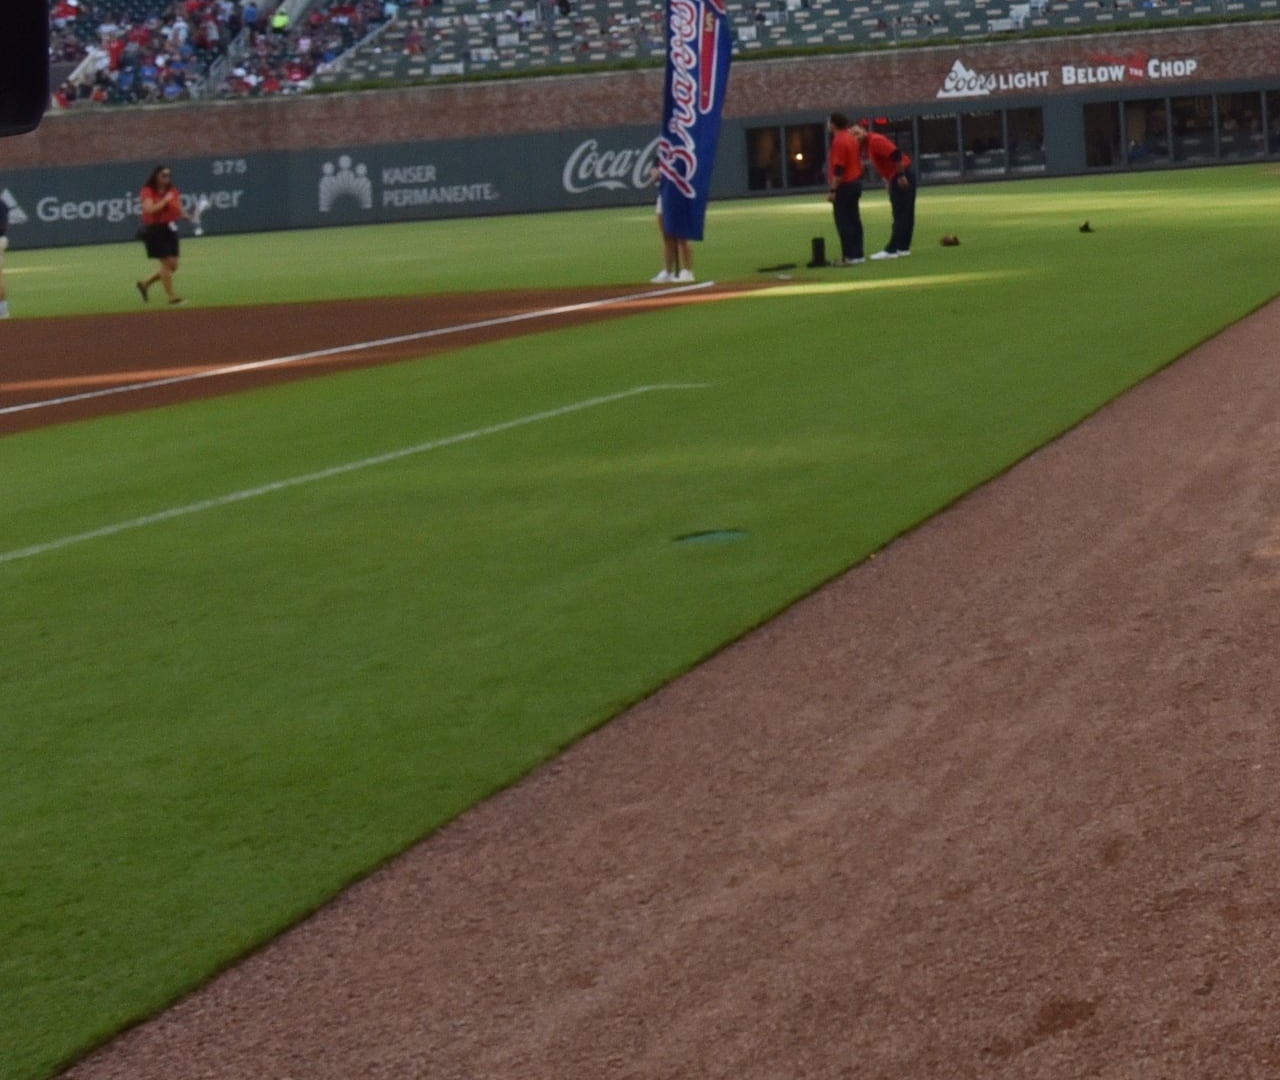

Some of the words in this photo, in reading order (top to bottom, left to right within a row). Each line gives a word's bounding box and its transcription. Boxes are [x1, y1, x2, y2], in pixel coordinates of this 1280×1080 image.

[943, 69, 998, 94] Coors
[999, 70, 1049, 91] LIGHT
[1062, 64, 1125, 85] BELOW
[1147, 59, 1197, 79] CHOP
[382, 165, 437, 185] KAISER
[36, 191, 144, 222] Georgia
[383, 183, 492, 207] PERMANENTE
